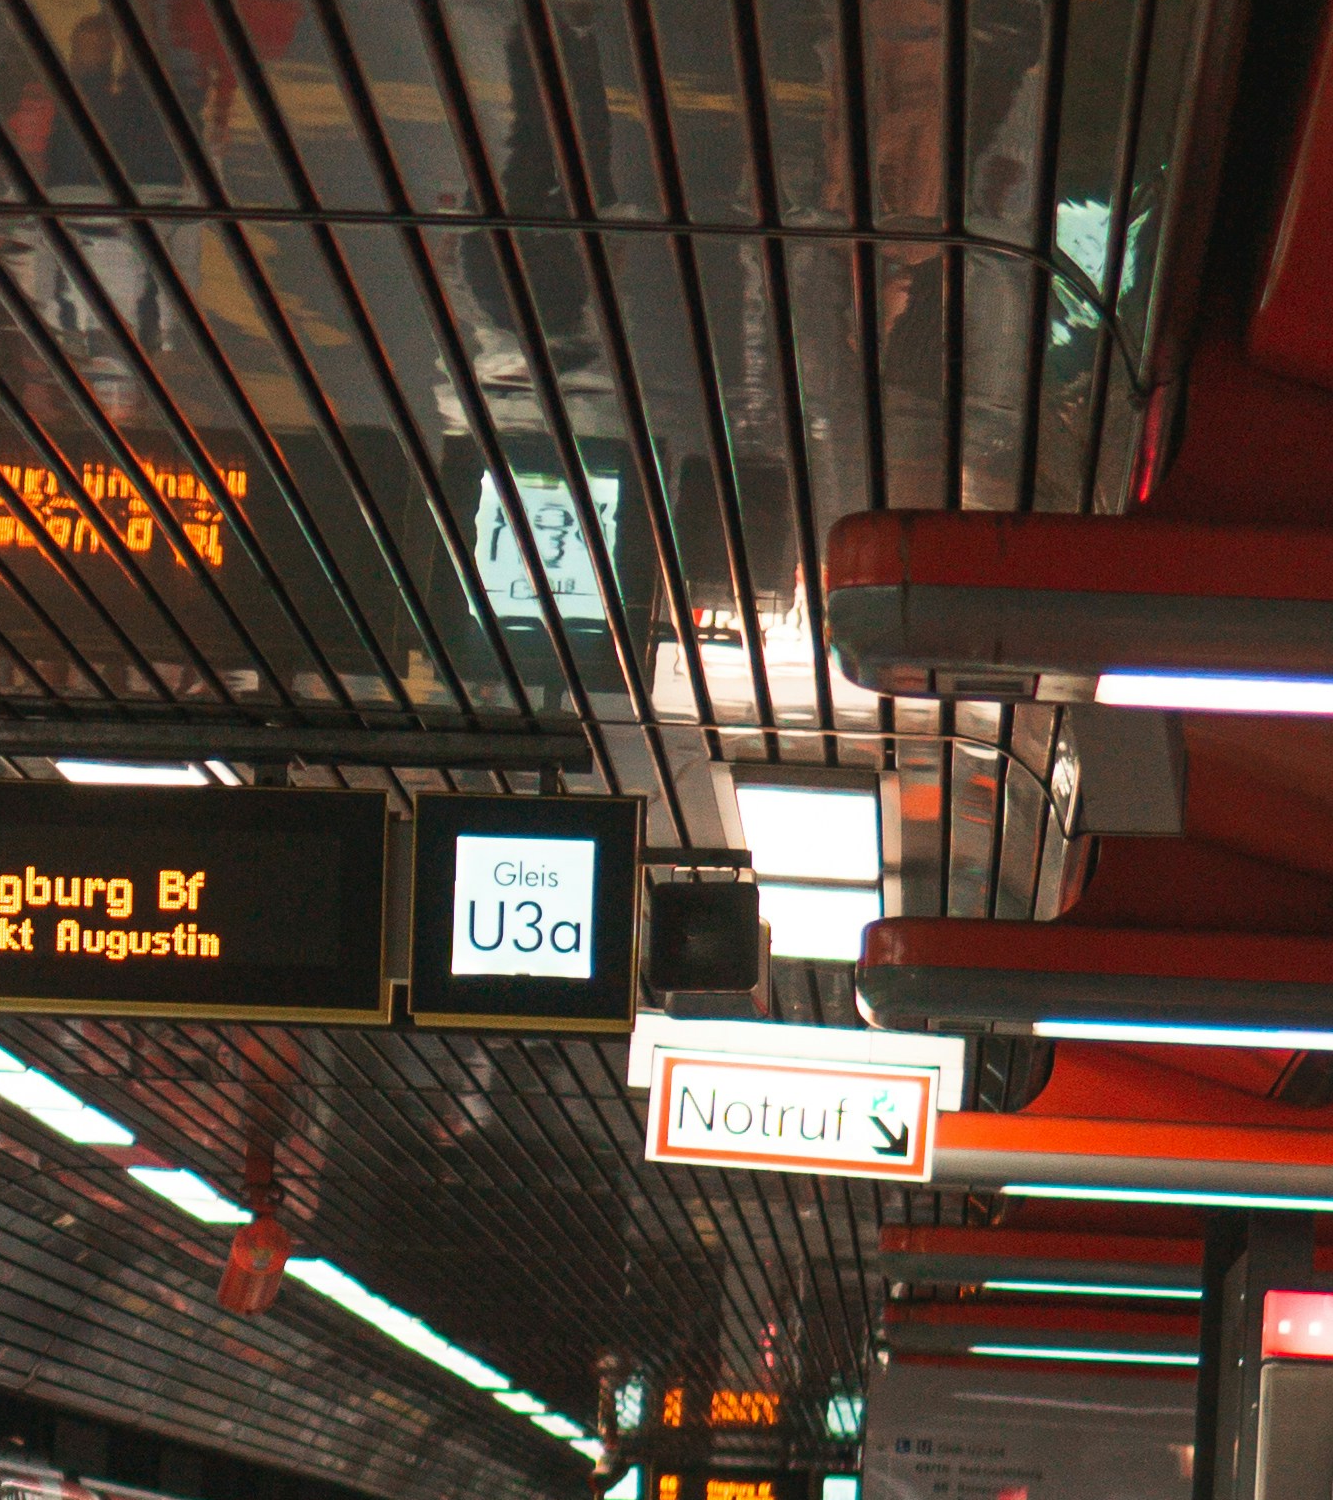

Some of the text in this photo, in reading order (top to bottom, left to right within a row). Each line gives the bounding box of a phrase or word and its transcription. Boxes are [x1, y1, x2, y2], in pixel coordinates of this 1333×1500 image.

[158, 869, 206, 912] Bf
[493, 860, 559, 888] Gleis
[55, 921, 220, 961] Augustin
[469, 899, 581, 953] U3a
[678, 1086, 847, 1141] Notruf
